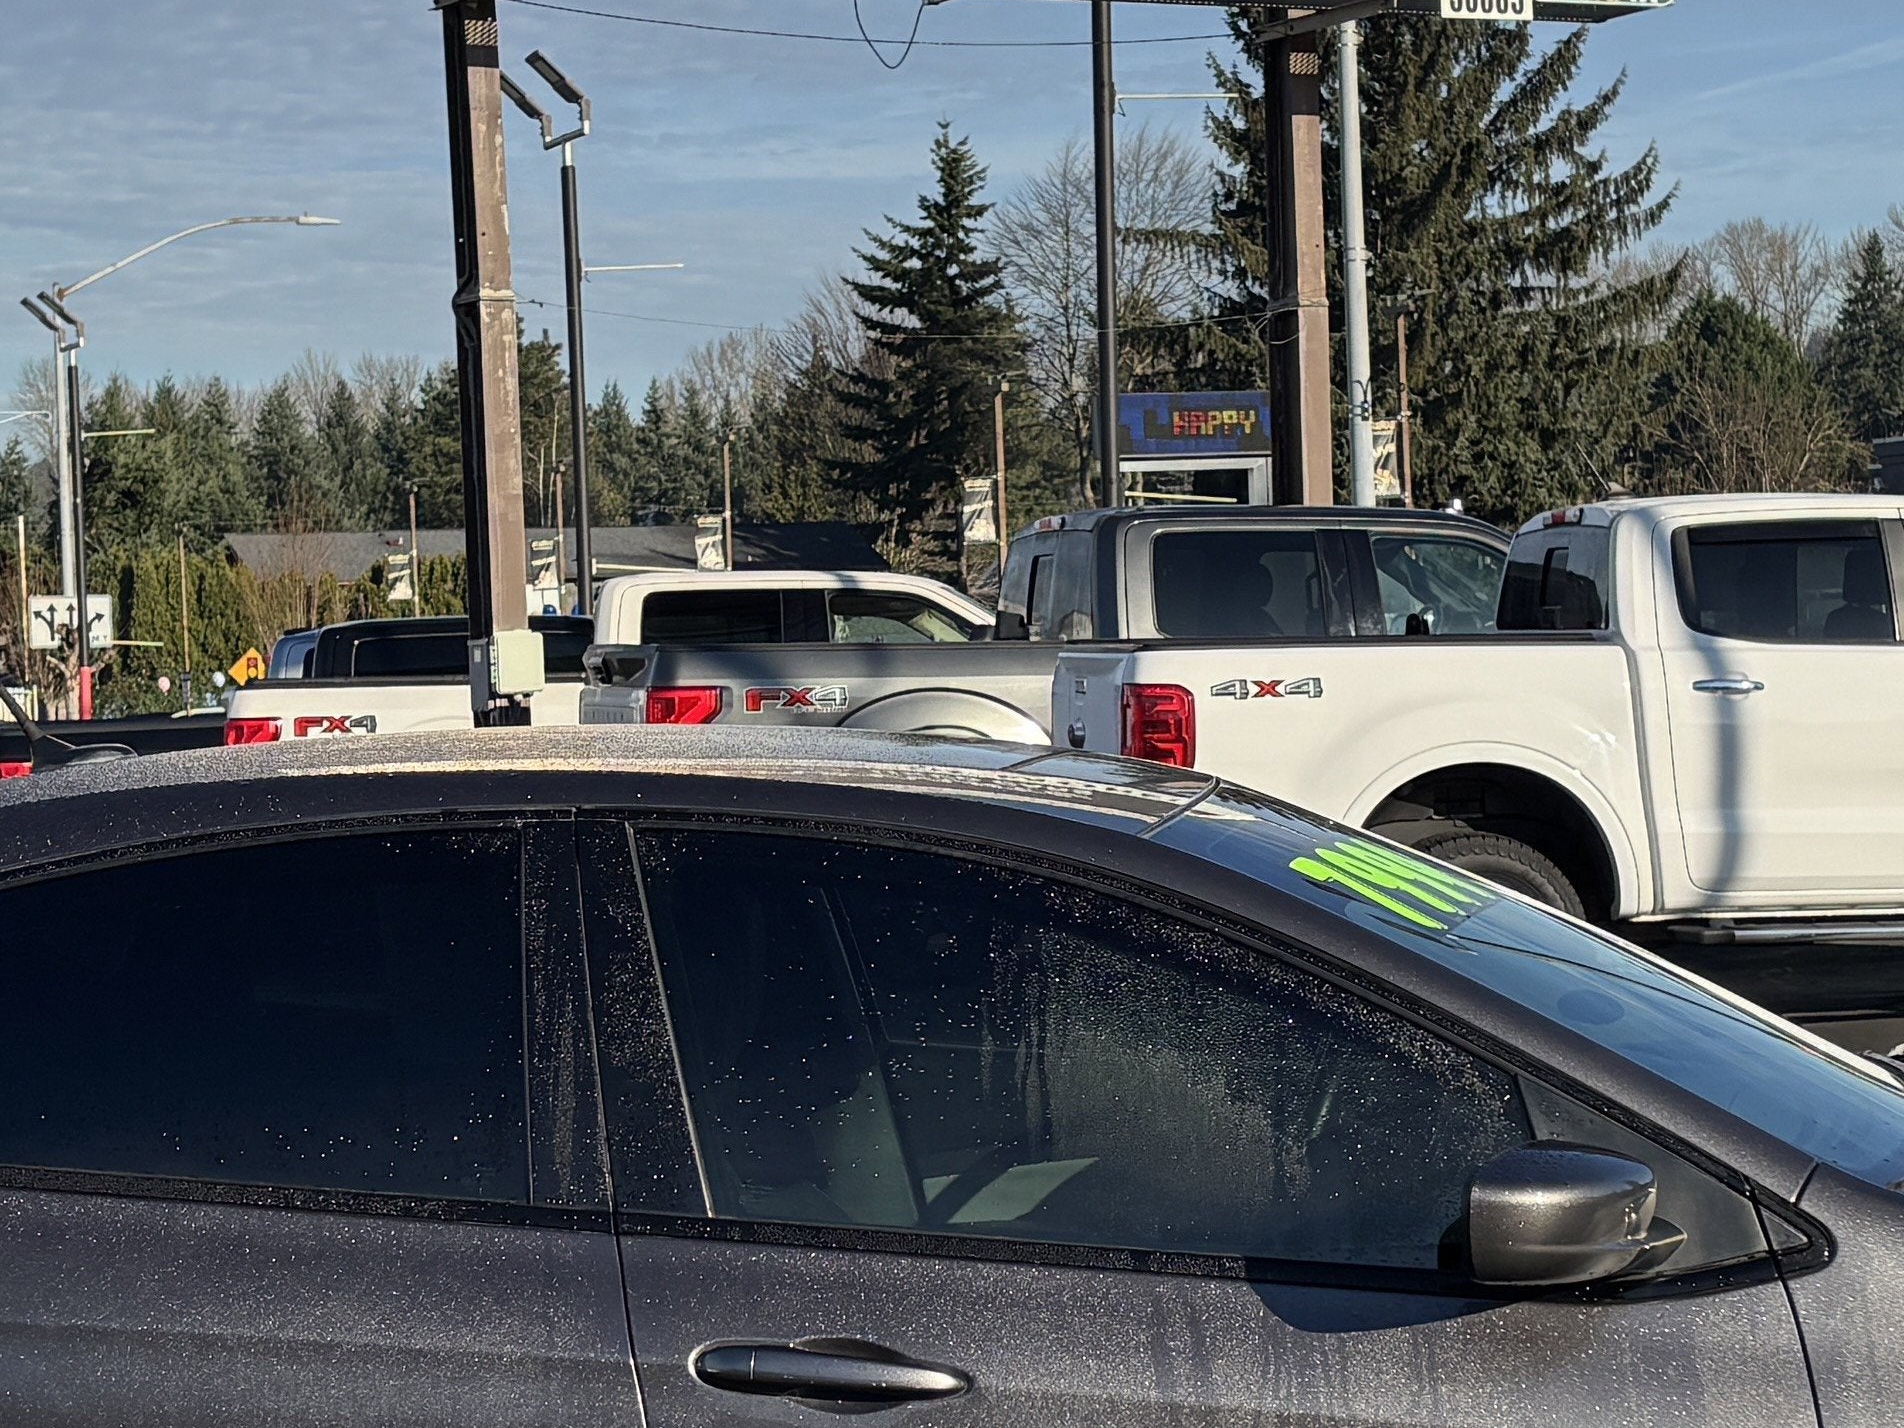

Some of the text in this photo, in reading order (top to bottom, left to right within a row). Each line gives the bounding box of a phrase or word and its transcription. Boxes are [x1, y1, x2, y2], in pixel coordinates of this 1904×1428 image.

[1173, 410, 1256, 436] HAPPY
[744, 685, 849, 713] FX4
[294, 715, 377, 737] FX4
